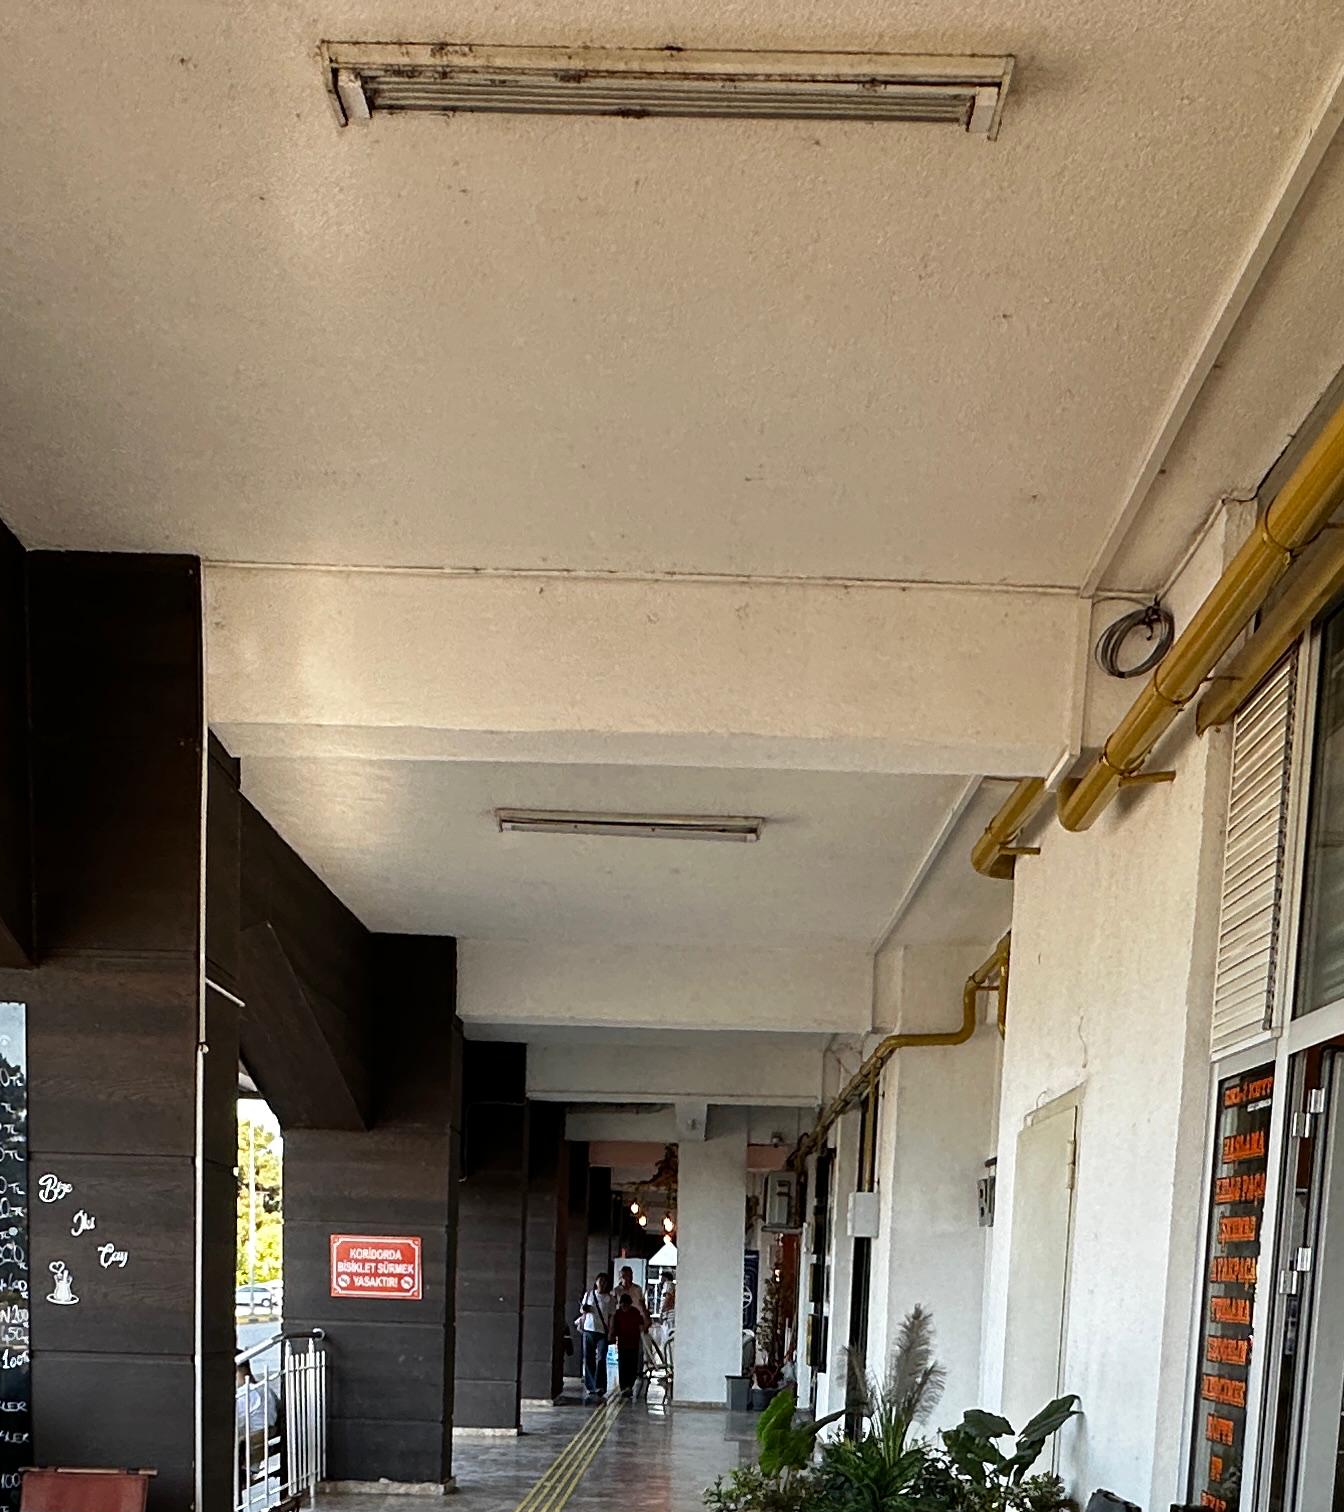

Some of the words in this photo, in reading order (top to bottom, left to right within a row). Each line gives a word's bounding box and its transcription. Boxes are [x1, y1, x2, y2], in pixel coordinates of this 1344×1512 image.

[350, 1247, 402, 1260] KORİDORDA
[338, 1260, 376, 1273] BİSİKLET
[377, 1261, 414, 1274] SÜRMEK
